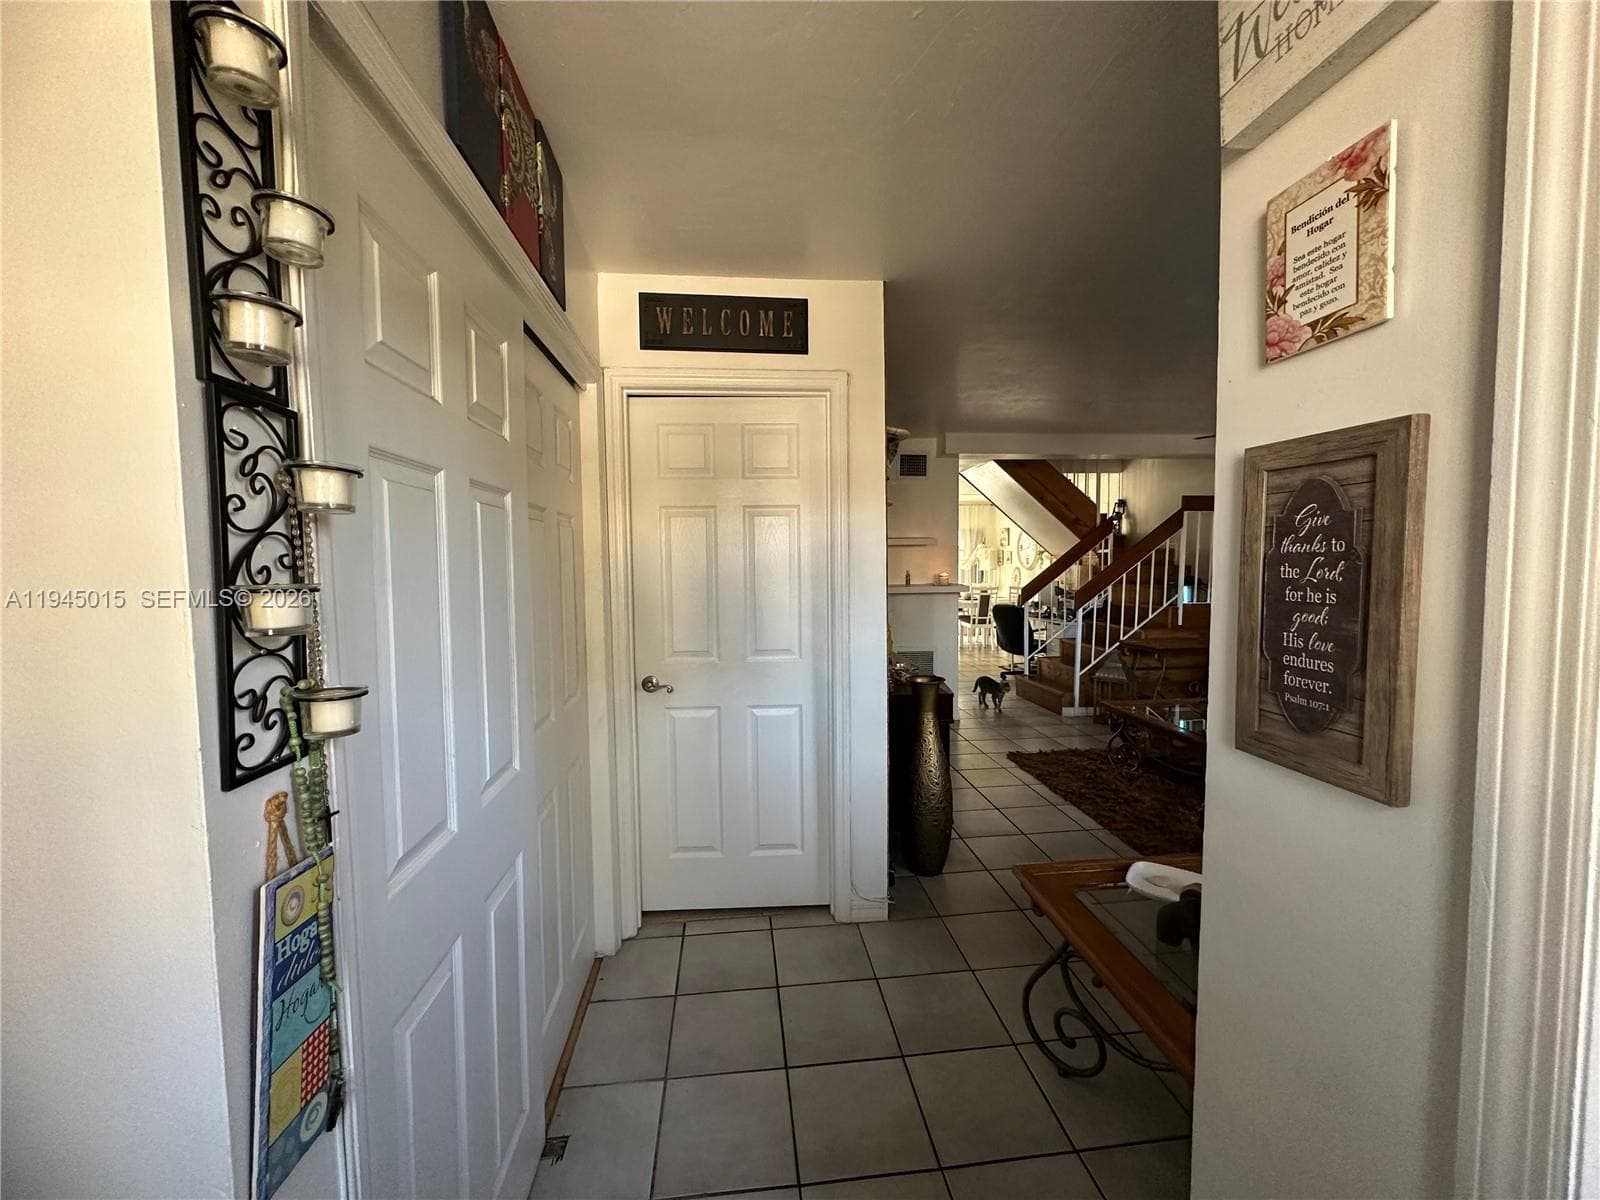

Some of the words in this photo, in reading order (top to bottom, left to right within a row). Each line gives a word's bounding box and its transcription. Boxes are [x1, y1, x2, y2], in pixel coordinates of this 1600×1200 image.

[1274, 0, 1345, 64] HOM
[1290, 205, 1334, 235] Bendición
[1335, 191, 1350, 208] del
[1306, 216, 1334, 237] Hogar
[1293, 253, 1306, 265] Sea
[1306, 244, 1322, 257] este
[1323, 231, 1346, 249] hogar
[1293, 250, 1330, 274] bendecido
[1331, 241, 1346, 255] con
[1314, 254, 1341, 272] calidez
[1295, 271, 1325, 292] amistad.
[1329, 263, 1344, 275] Sea
[1299, 286, 1314, 299] este
[1315, 275, 1338, 290] hogar
[1292, 289, 1330, 312] bendecido
[1330, 282, 1346, 295] con
[1299, 307, 1312, 320] paz
[1319, 296, 1340, 311] gozo.
[656, 306, 793, 338] WELCOME
[1294, 503, 1332, 537] Give
[1280, 533, 1327, 554] thanks
[1330, 537, 1346, 553] to
[1280, 562, 1300, 579] the
[1284, 585, 1304, 602] for
[1306, 586, 1322, 603] he
[1325, 587, 1337, 605] is
[1282, 631, 1304, 648] His
[1308, 632, 1336, 652] love
[1282, 652, 1335, 673] endures
[1283, 670, 1333, 695] forever.
[1284, 692, 1307, 706] Psalm
[1309, 699, 1329, 711] 107:1
[275, 920, 318, 967] Hoga
